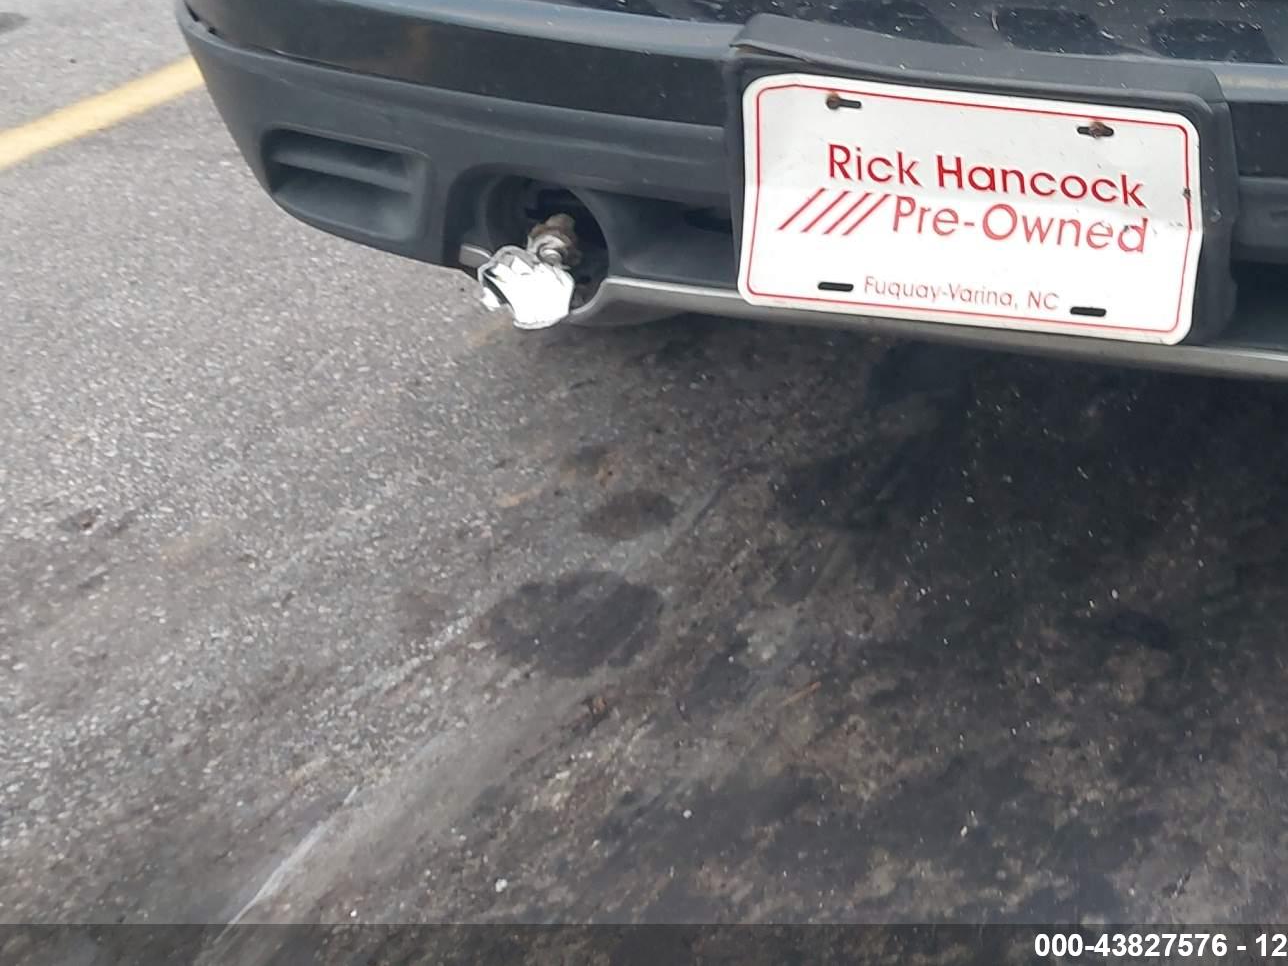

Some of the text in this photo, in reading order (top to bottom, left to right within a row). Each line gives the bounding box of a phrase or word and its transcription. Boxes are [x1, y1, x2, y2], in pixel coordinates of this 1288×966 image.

[828, 143, 1147, 208] Rick Hancock
[892, 195, 1150, 254] Pre-Owned
[863, 276, 1060, 312] Fuquay-Varina, NC
